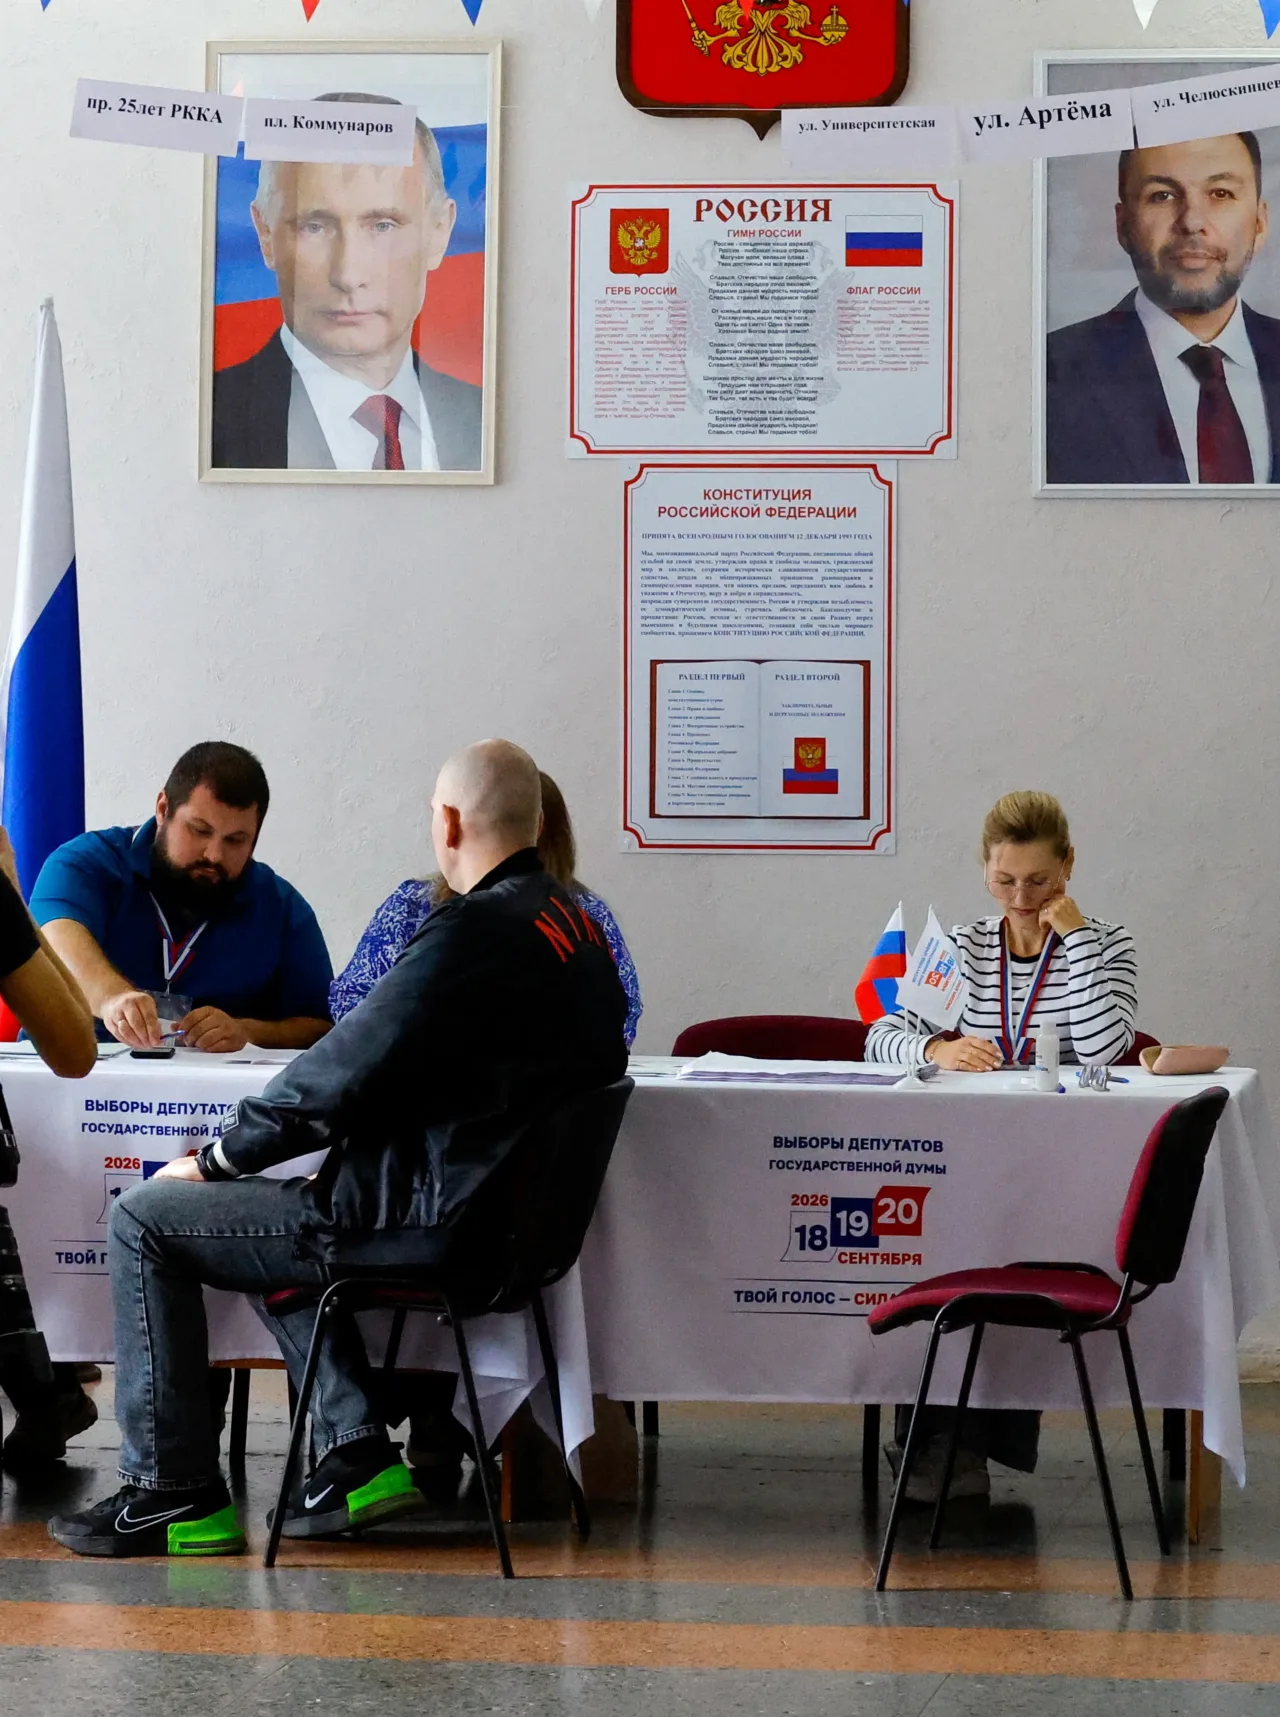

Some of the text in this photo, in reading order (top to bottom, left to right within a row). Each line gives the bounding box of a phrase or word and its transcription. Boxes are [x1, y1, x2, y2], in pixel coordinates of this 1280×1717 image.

[87, 96, 223, 124] пр. 25лет РККА
[1153, 96, 1175, 113] ул.
[264, 115, 394, 134] пл. Коммунаров
[798, 118, 936, 134] ул. Университетская
[973, 100, 1112, 136] ул. Артёма
[693, 198, 832, 222] РОССИЯ
[727, 229, 802, 238] ГИМН РОССИИ
[605, 286, 678, 296] ГЕРБ РОССИИ
[846, 286, 921, 296] ФЛАГ РОССИИ
[703, 488, 812, 502] КОНСТИТУЦИЯ
[658, 504, 858, 520] РОССИЙСКОЙ ФЕДЕРАЦИИ
[85, 1100, 233, 1116] ВЫБОРЫ ДЕПУТАТ
[82, 1122, 208, 1137] ГОСУДАРСТВЕННОЙ
[773, 1136, 944, 1152] ВЫБОРЫ ДЕПУТАТОВ
[104, 1157, 141, 1170] 2026
[769, 1160, 946, 1175] ГОСУДАРСТВЕННОЙ ДУМЫ
[791, 1194, 828, 1206] 2026
[794, 1198, 919, 1251] 18 19 20
[56, 1250, 96, 1264] ТВОЙ
[838, 1252, 922, 1265] СЕНТЯБРЯ
[734, 1288, 777, 1304] ТВОЙ
[782, 1291, 835, 1304] ГОЛОС
